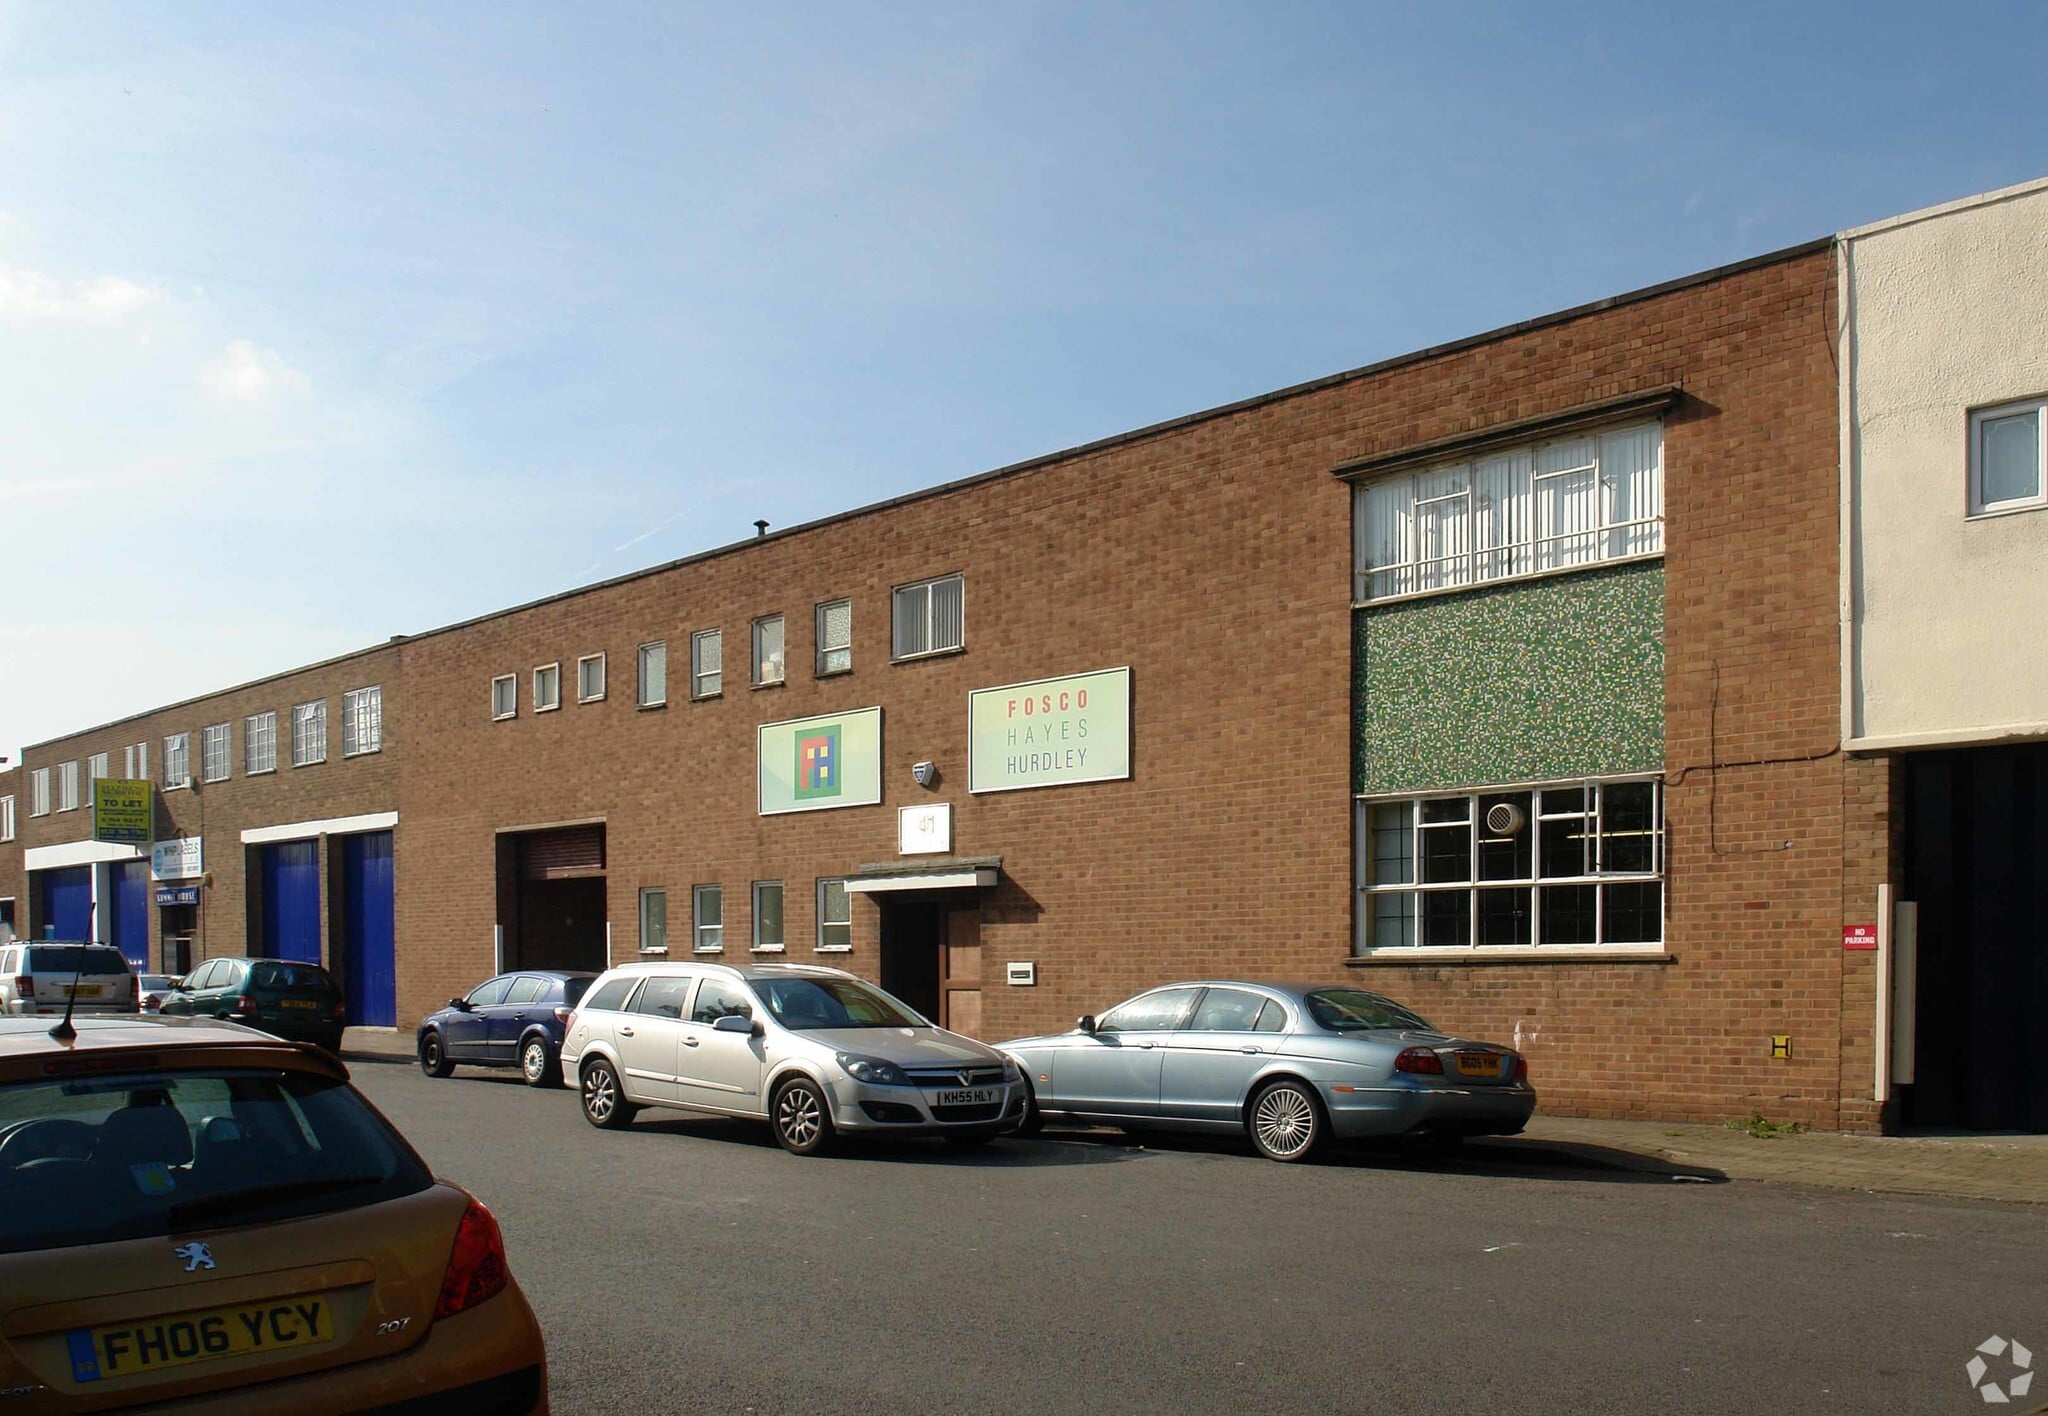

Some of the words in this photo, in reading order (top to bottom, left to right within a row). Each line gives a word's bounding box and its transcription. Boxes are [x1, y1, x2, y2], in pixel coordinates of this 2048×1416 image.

[1007, 689, 1088, 718] FOSCO
[1007, 718, 1088, 747] HAYES
[1007, 747, 1088, 774] HURDLEY
[103, 799, 118, 807] TO
[122, 799, 143, 808] LET
[1845, 936, 1875, 944] PARKING
[1854, 928, 1865, 936] NO
[1771, 1036, 1791, 1057] H
[944, 1091, 972, 1103] KH55
[974, 1090, 993, 1102] HLY
[103, 1317, 230, 1370] FH06
[240, 1302, 322, 1347] YCY
[376, 1316, 411, 1336] 207
